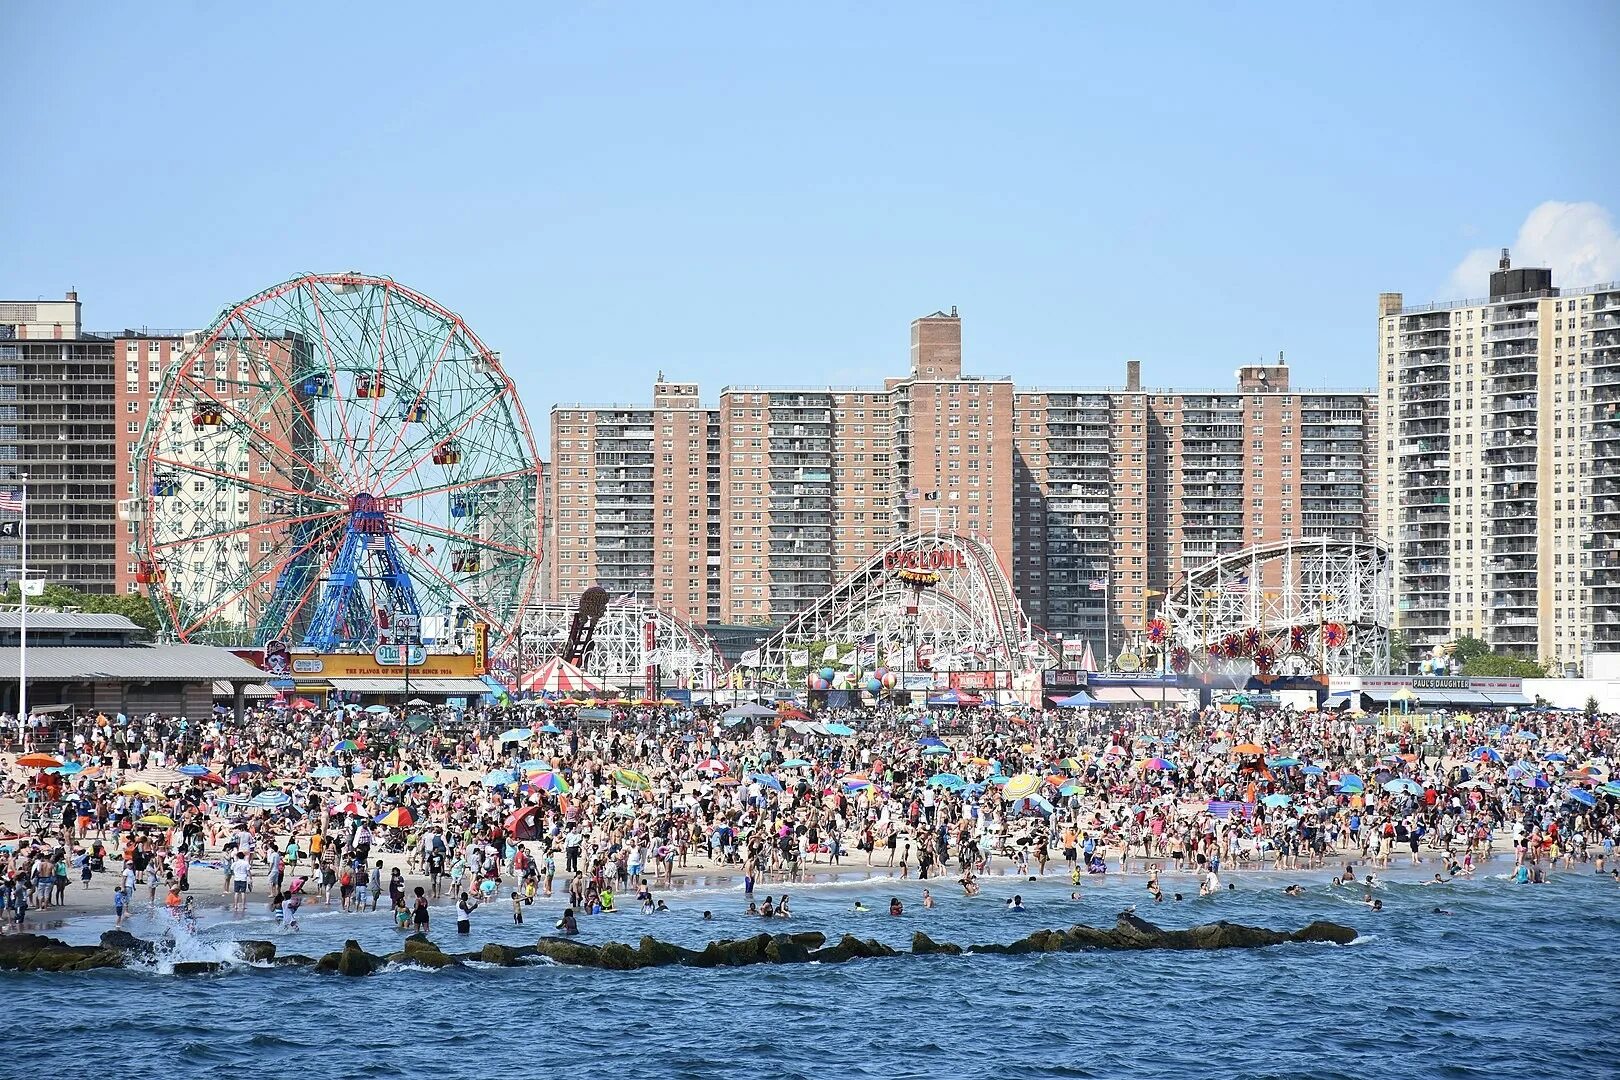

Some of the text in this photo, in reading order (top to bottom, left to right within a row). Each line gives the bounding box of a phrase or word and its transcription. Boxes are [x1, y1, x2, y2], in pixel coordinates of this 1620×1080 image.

[348, 498, 402, 513] WONDER
[884, 550, 967, 570] CYCLONE
[1414, 679, 1434, 688] PAUL'S
[1435, 680, 1469, 688] DAUGHTER
